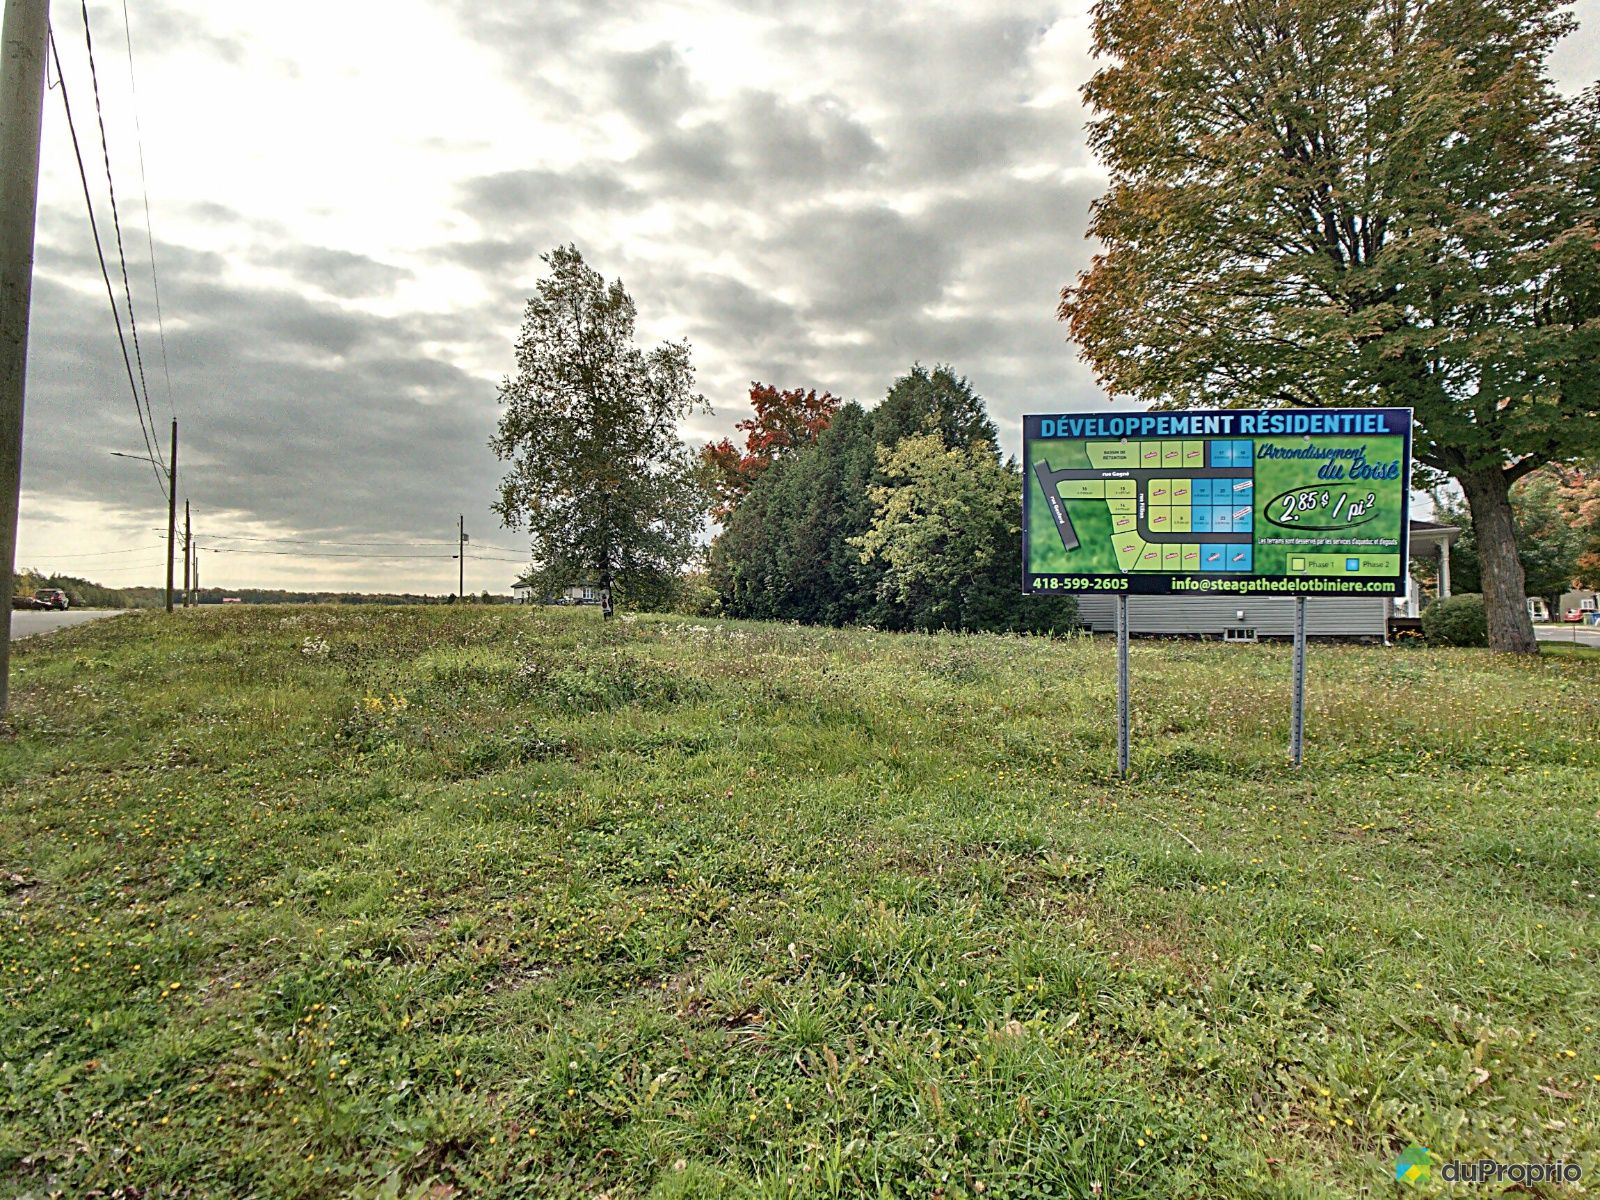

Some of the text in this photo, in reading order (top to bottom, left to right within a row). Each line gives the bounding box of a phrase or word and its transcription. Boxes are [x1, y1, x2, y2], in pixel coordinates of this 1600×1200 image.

[1041, 411, 1390, 437] DÉVELOPPEMENT RÉSIDENTIEL
[1257, 443, 1367, 459] L'Arrondissement
[1317, 457, 1400, 480] du Boisé
[1032, 577, 1129, 590] 418-599-2605
[1171, 577, 1396, 594] info@steagathedelotbiniere.com
